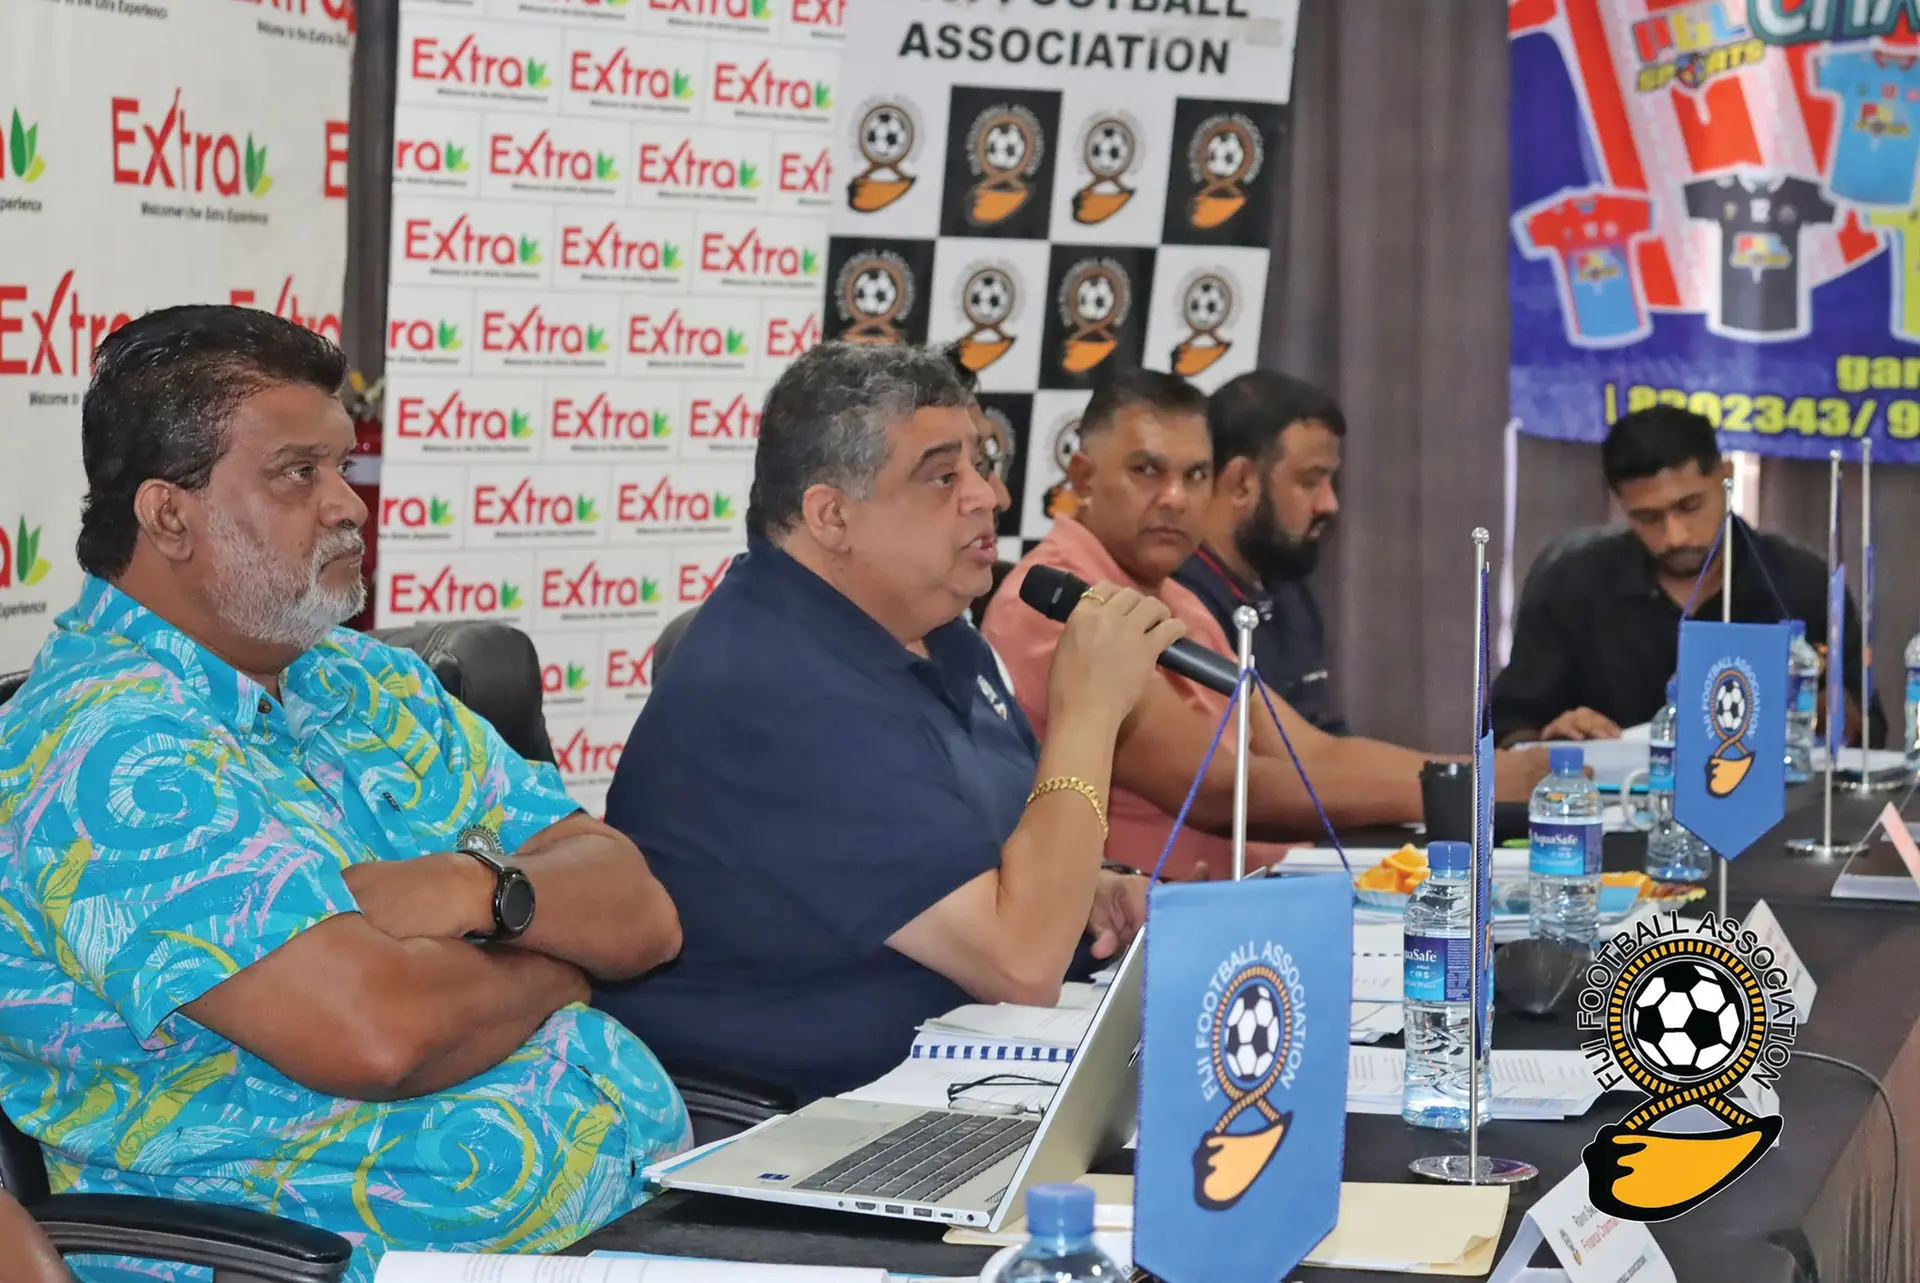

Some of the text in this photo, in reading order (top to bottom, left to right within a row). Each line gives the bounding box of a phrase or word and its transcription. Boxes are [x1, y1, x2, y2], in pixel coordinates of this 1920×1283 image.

[412, 32, 523, 88] Extra
[570, 47, 670, 99] Extra
[898, 22, 1229, 75] ASSOCIATION
[713, 59, 812, 110] Extra
[111, 88, 241, 198] Extra
[489, 130, 593, 182] Extra
[639, 139, 736, 190] Extra
[404, 214, 516, 265] Extra
[561, 222, 660, 271] Extra
[701, 228, 798, 277] Extra
[482, 305, 584, 355] Extra
[628, 309, 724, 357] Extra
[397, 390, 507, 441] Extra
[551, 392, 650, 441] Extra
[473, 477, 573, 526] Extra
[617, 477, 711, 523] Extra
[389, 565, 498, 614] Extra
[542, 561, 638, 610] Extra
[1196, 940, 1307, 1103] FIJI FOOTBALL ASSOCIATION
